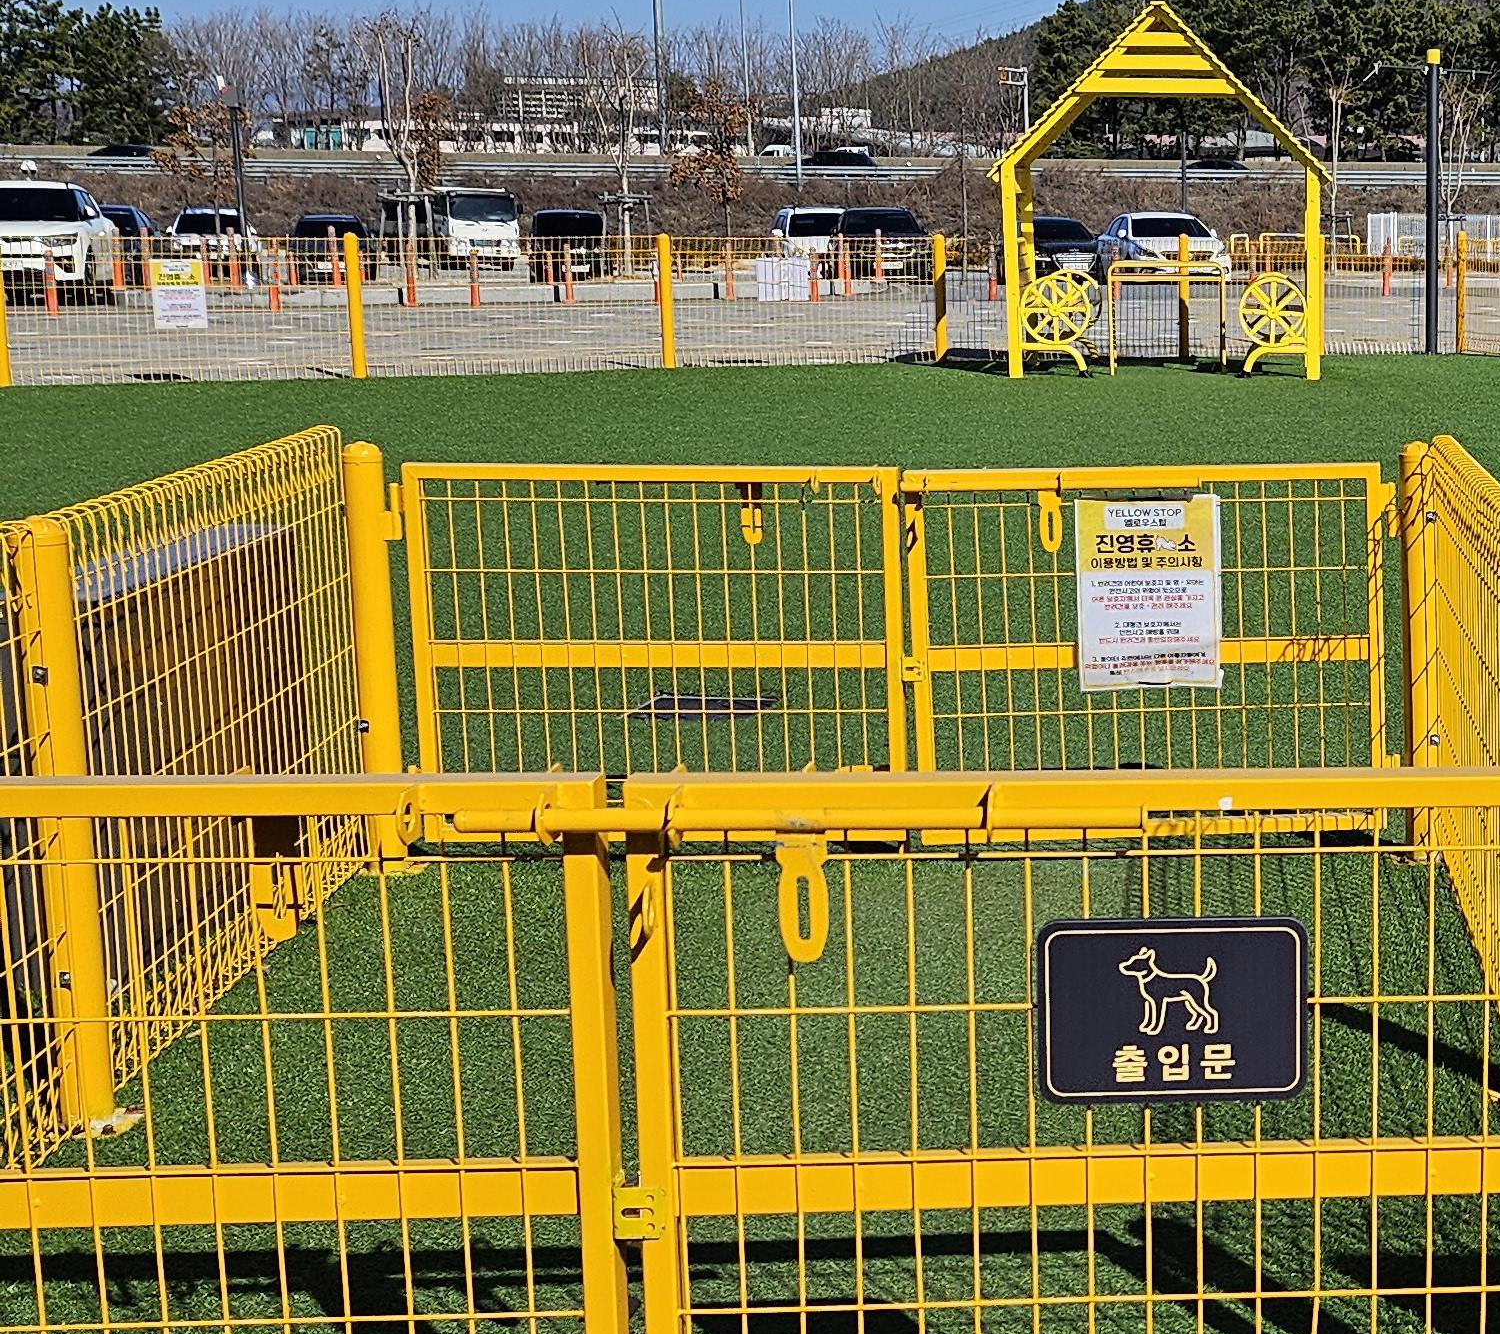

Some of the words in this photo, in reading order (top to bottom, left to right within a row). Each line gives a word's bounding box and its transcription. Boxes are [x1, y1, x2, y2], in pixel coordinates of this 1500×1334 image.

[1108, 509, 1151, 517] YELLOW
[1153, 508, 1182, 517] STOP
[1091, 557, 1138, 569] 이용방법
[1142, 556, 1153, 568] 및
[1156, 556, 1203, 568] 주의사항
